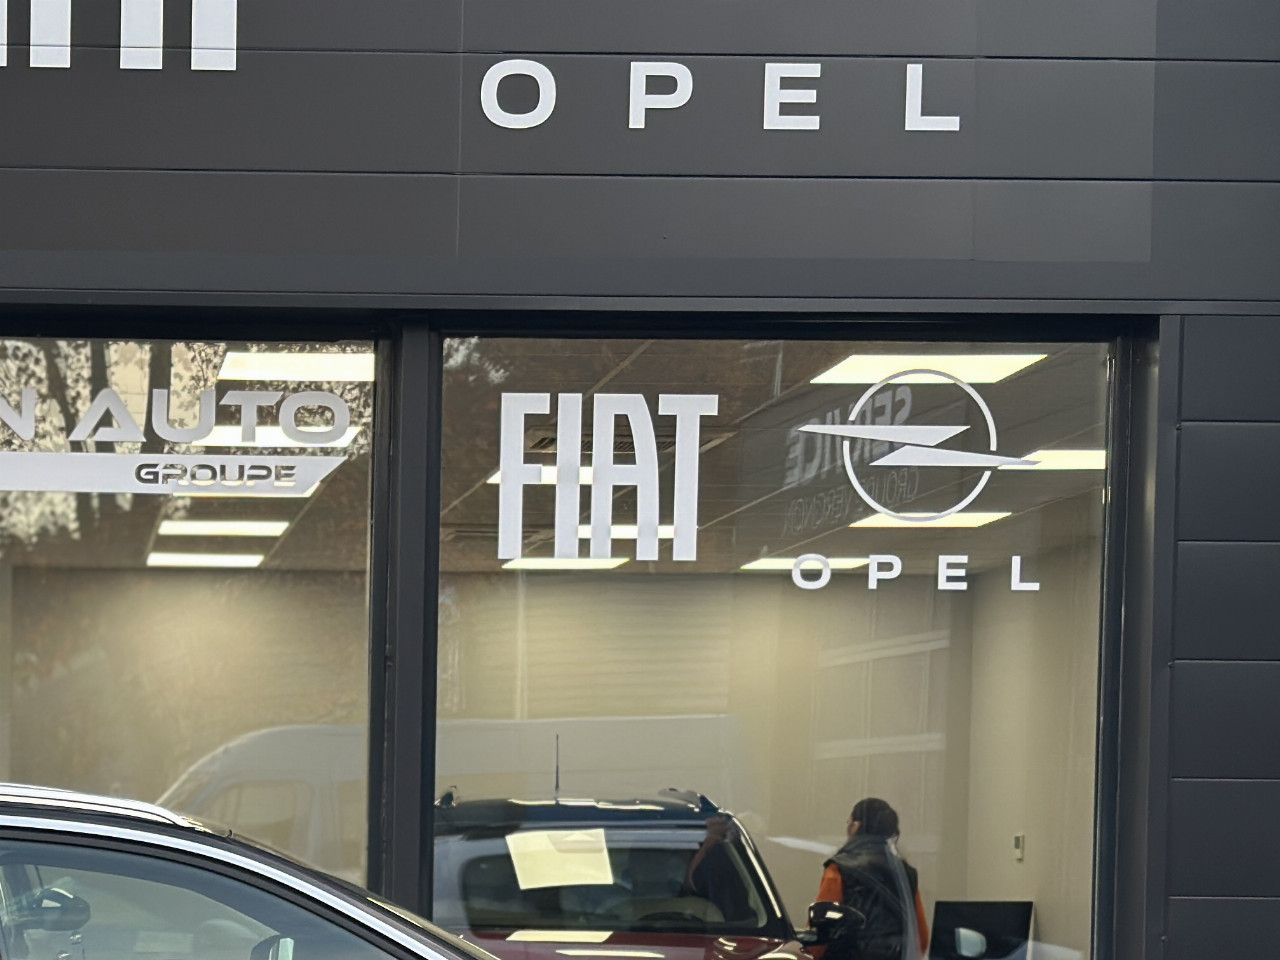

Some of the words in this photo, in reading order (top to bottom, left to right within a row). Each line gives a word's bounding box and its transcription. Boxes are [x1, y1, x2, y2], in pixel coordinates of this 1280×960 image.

[480, 58, 960, 131] OPEL
[69, 387, 352, 444] AUTO
[135, 462, 297, 486] GROUPE
[498, 393, 719, 561] FIAT
[791, 553, 1040, 591] OPEL
